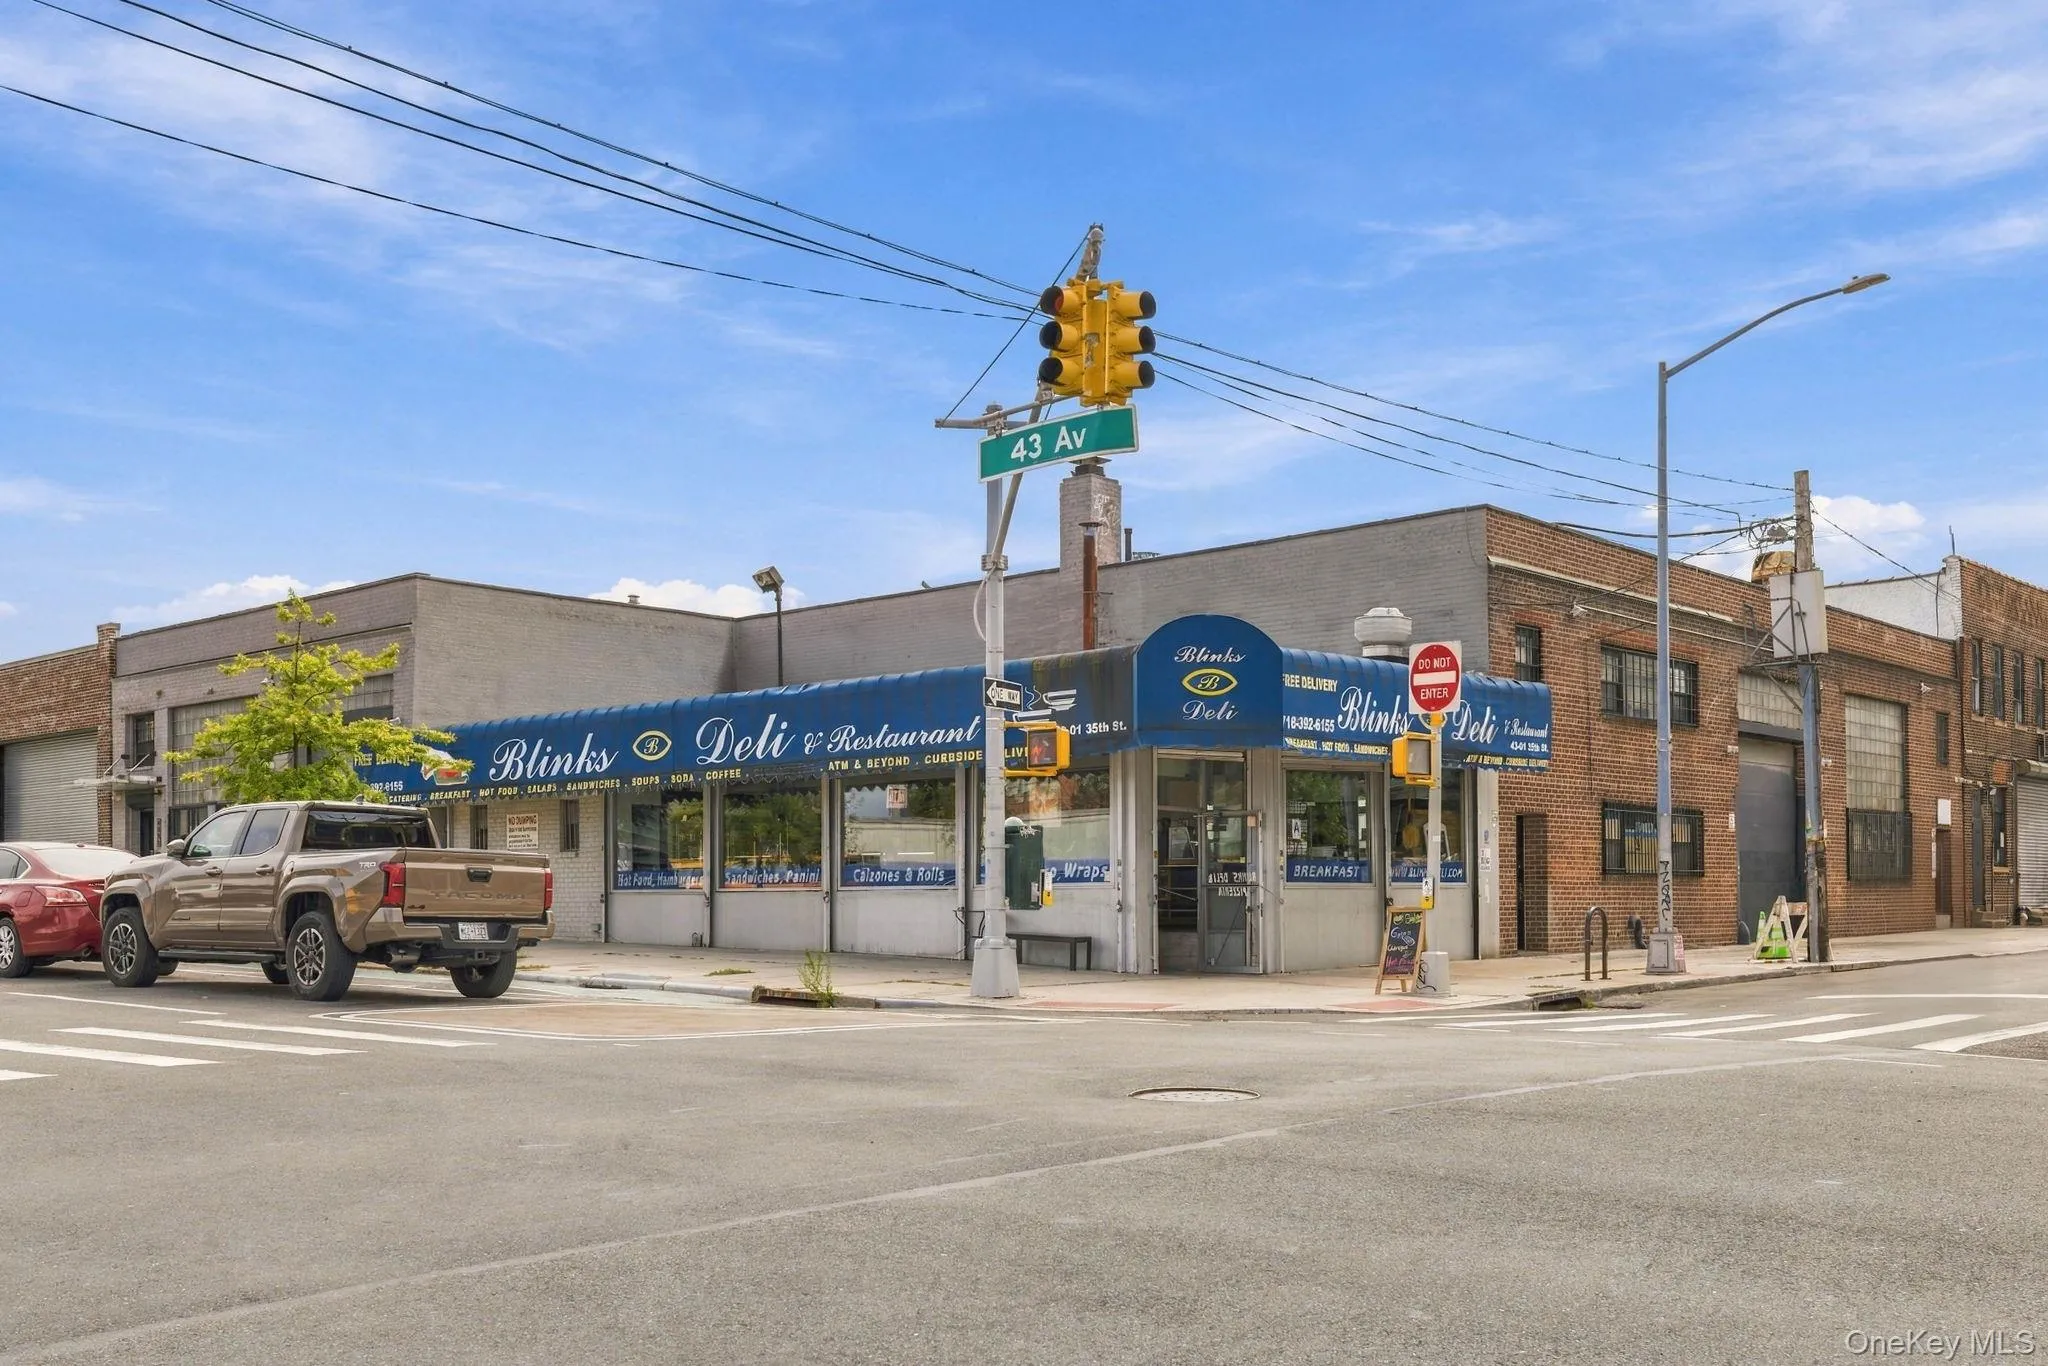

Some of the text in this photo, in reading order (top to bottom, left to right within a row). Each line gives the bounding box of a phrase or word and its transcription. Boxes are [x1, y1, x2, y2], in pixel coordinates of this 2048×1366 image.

[1011, 426, 1087, 462] 43 Av
[1174, 646, 1246, 663] Blinks
[1418, 656, 1451, 670] DO NOT
[1282, 673, 1338, 693] REE DELIVERY
[990, 687, 1019, 702] ONE WAY
[1420, 687, 1449, 700] ENTER
[1182, 699, 1239, 721] Deli
[1337, 686, 1415, 735] Blinks
[1452, 700, 1500, 744] Deli
[1510, 718, 1549, 738] Restaurant
[1085, 722, 1109, 734] 35th
[1112, 720, 1127, 731] St.
[489, 733, 619, 782] Blinks
[695, 713, 796, 765] Deli
[827, 715, 982, 753] Restaurant
[389, 750, 983, 803] CATERING BREAKFAST HOT FOOD SALADS SANDWICHES SOUPS SODA COFFEE ATM & BEYOND CURBSIDE
[1293, 822, 1300, 833] A
[786, 868, 820, 883] Panini
[853, 866, 945, 882] Calzones & Rolls
[1064, 862, 1108, 882] Wraps
[1294, 865, 1360, 877] BREAKFAST
